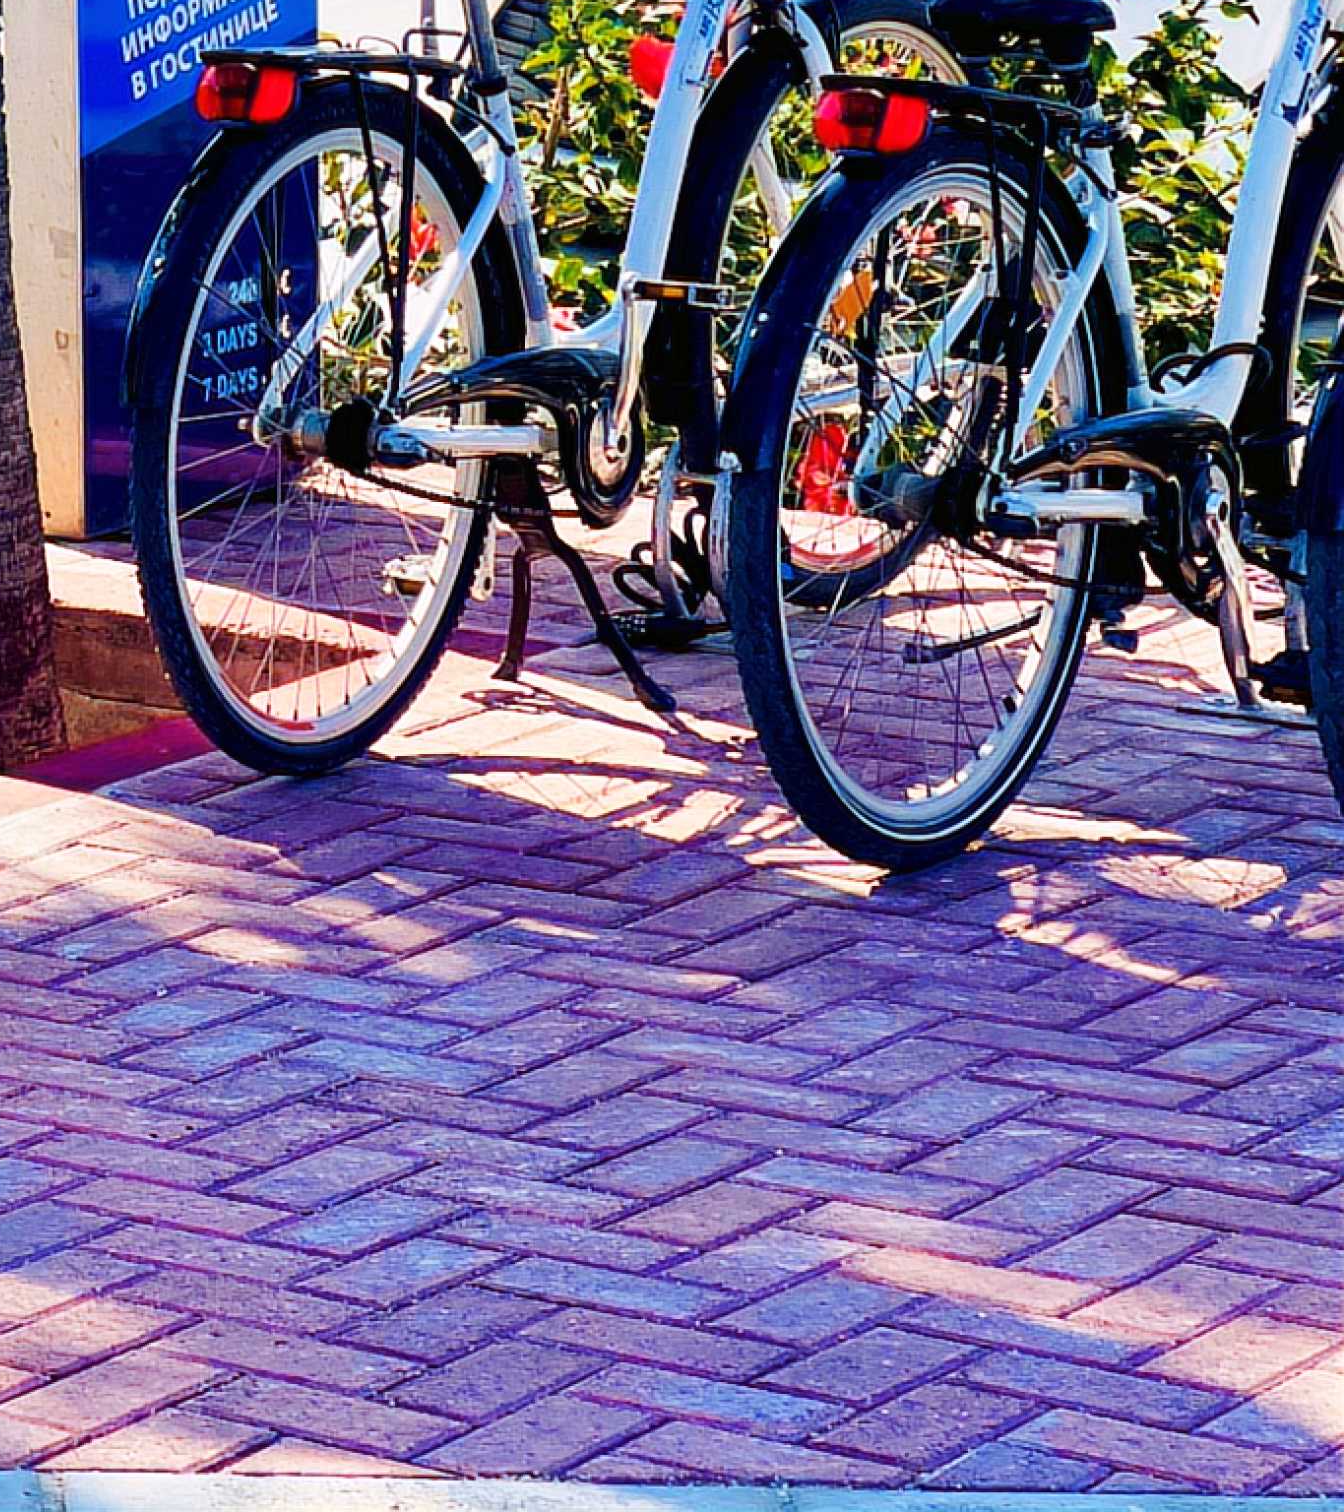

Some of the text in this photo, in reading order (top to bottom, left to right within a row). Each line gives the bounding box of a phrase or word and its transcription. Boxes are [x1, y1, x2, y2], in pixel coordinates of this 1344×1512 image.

[130, 70, 147, 101] В
[216, 322, 259, 355] DAYS
[216, 365, 259, 399] DAYS
